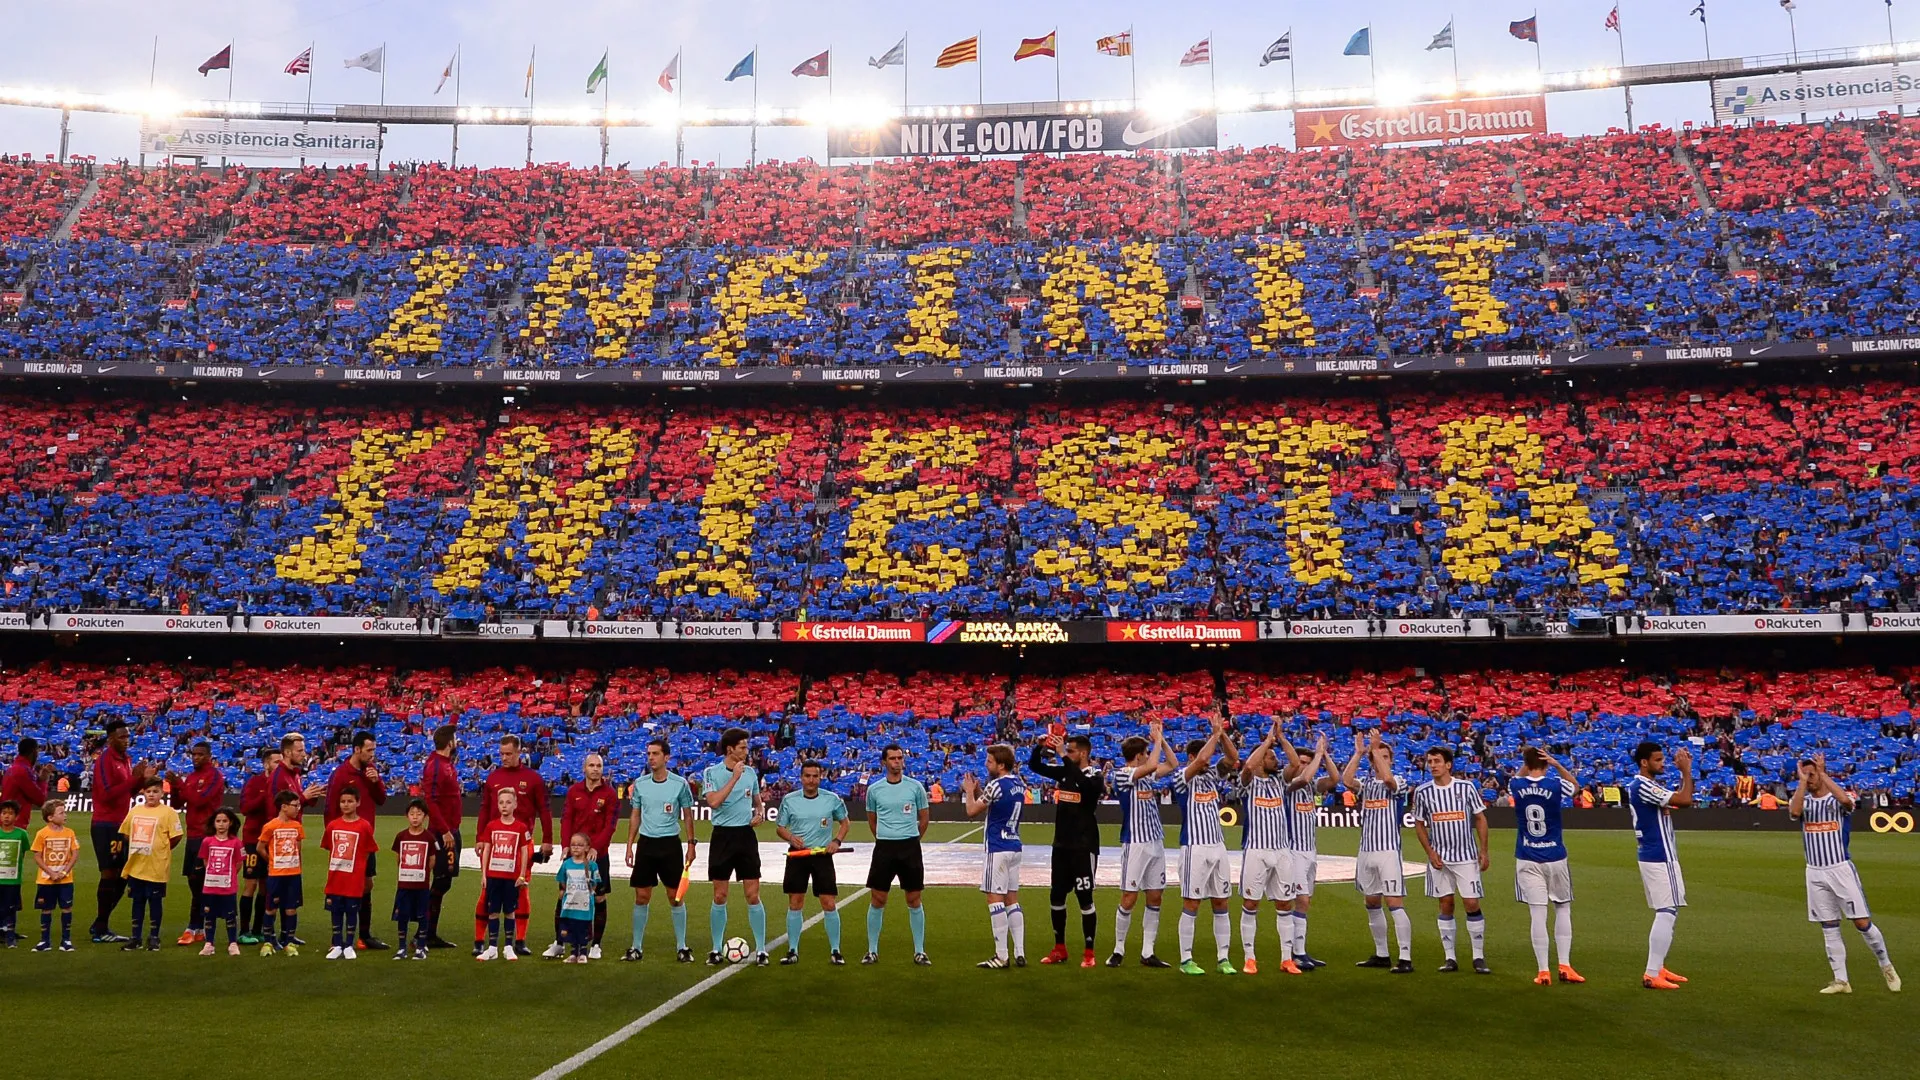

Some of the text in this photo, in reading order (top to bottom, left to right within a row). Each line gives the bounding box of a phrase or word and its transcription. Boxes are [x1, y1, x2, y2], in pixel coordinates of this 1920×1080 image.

[1761, 78, 1893, 104] Assistència
[1339, 108, 1535, 140] Estrella Damm
[179, 128, 376, 149] Assistència Sanitària
[902, 118, 1103, 153] NIKE.COM/FCB
[1666, 346, 1732, 360] NIKE.COM/FCB
[24, 363, 83, 374] NIKE.COM/FCB
[1316, 360, 1377, 371] NIKE.COM/FCB
[344, 369, 402, 380] NIKE.COM/FCB
[503, 370, 561, 380] NIKE.COM/FCB
[662, 370, 720, 380] NIKE.COM/FCB
[822, 369, 880, 380] NIKE.COM/FCB
[984, 366, 1043, 377] NIKE.COM/FCB
[77, 618, 124, 628] Rakuten
[175, 619, 223, 628] Rakuten
[274, 620, 321, 629] Rakuten
[372, 620, 418, 631] Rakuten
[479, 623, 519, 634] akuten
[966, 622, 1063, 634] BARÇA, BARÇA,
[1410, 623, 1461, 633] Rakuten
[1653, 620, 1706, 630] Rakuten
[1766, 618, 1822, 628] Rakuten
[597, 625, 644, 634] Rakuten
[695, 626, 742, 636] Rakuten
[812, 623, 911, 640] Estrella Damm
[1139, 623, 1242, 639] Estrella Damm
[1303, 624, 1354, 634] Rakuten
[1525, 804, 1547, 837] 8
[110, 840, 123, 854] 24
[246, 854, 257, 867] 18
[447, 851, 455, 865] 3
[1076, 877, 1090, 890] 25
[1160, 872, 1166, 885] 3
[1384, 880, 1397, 893] 17
[1846, 901, 1856, 915] 7
